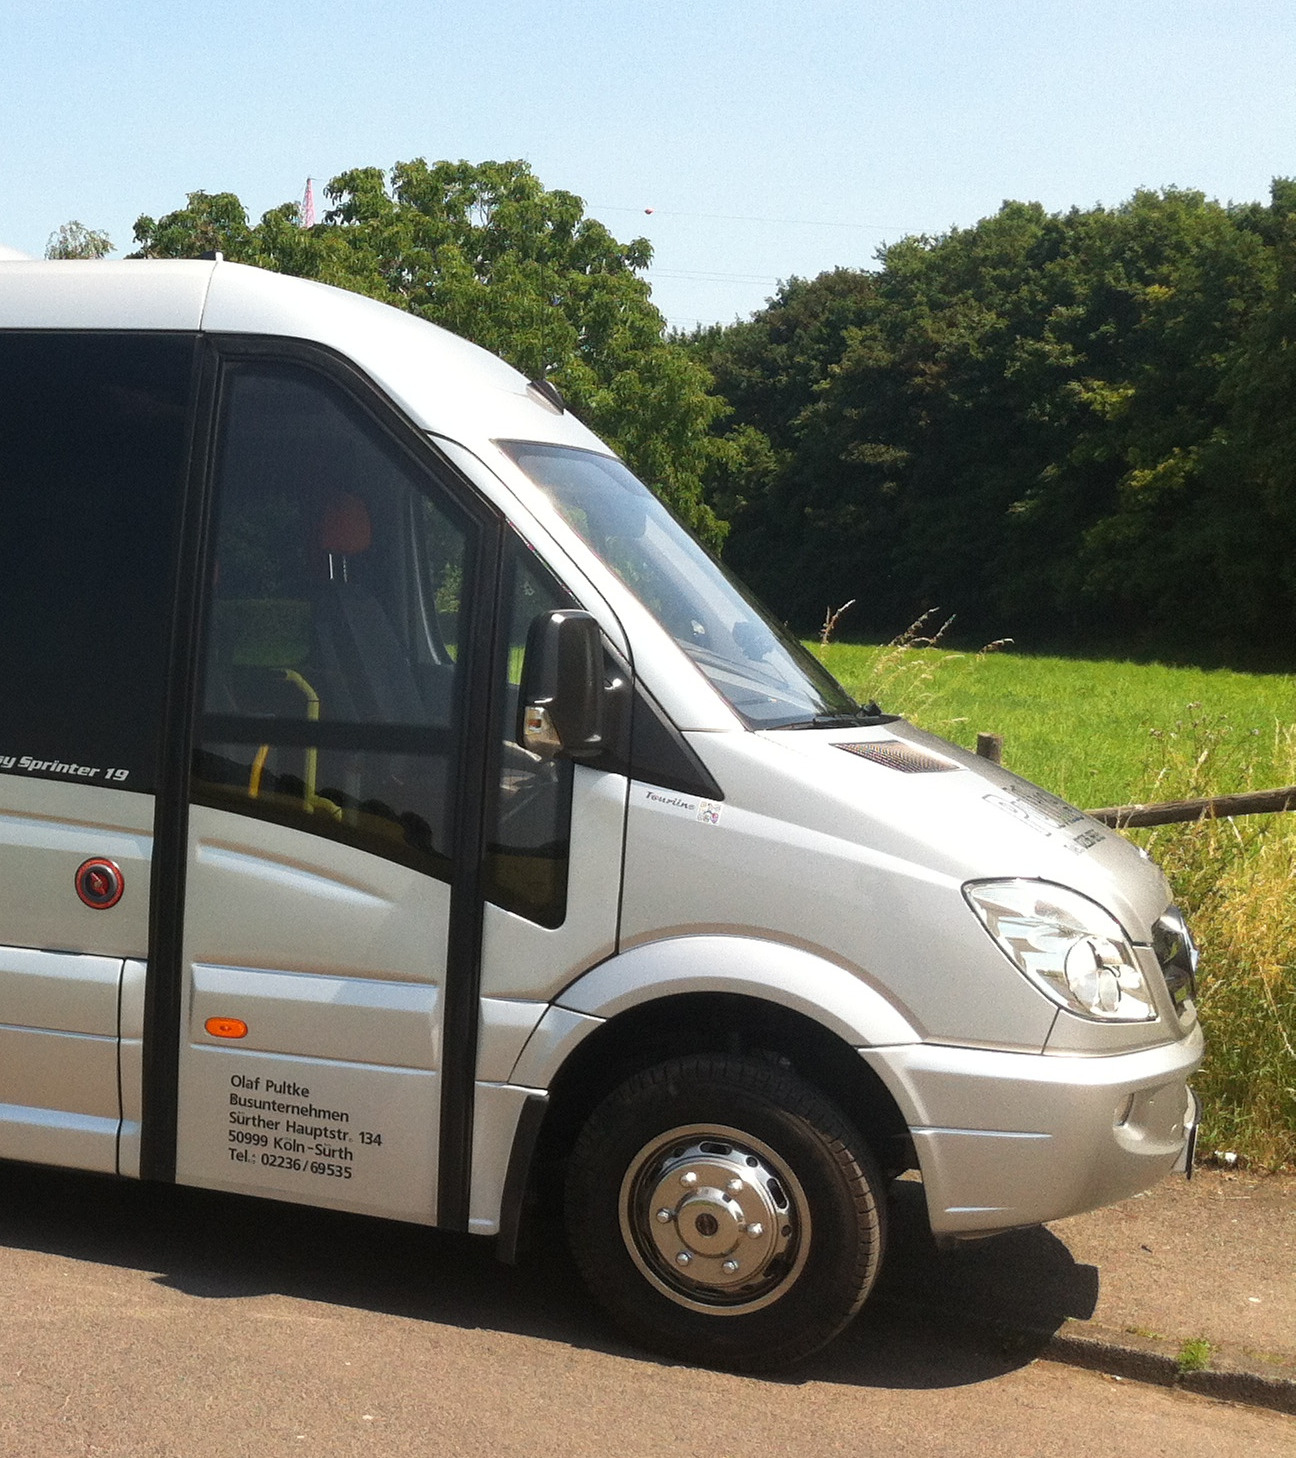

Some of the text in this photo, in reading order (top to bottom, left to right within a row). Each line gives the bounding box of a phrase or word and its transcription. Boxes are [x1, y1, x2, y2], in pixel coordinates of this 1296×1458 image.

[18, 756, 100, 778] Sprinter
[104, 767, 130, 782] 19
[230, 1074, 310, 1098] Olaf Pultke
[230, 1093, 349, 1122] Busunternehmen
[228, 1129, 268, 1147] 50999
[229, 1111, 383, 1147] Sürther Hauptstr. 134
[261, 1154, 352, 1179] 02236/69535
